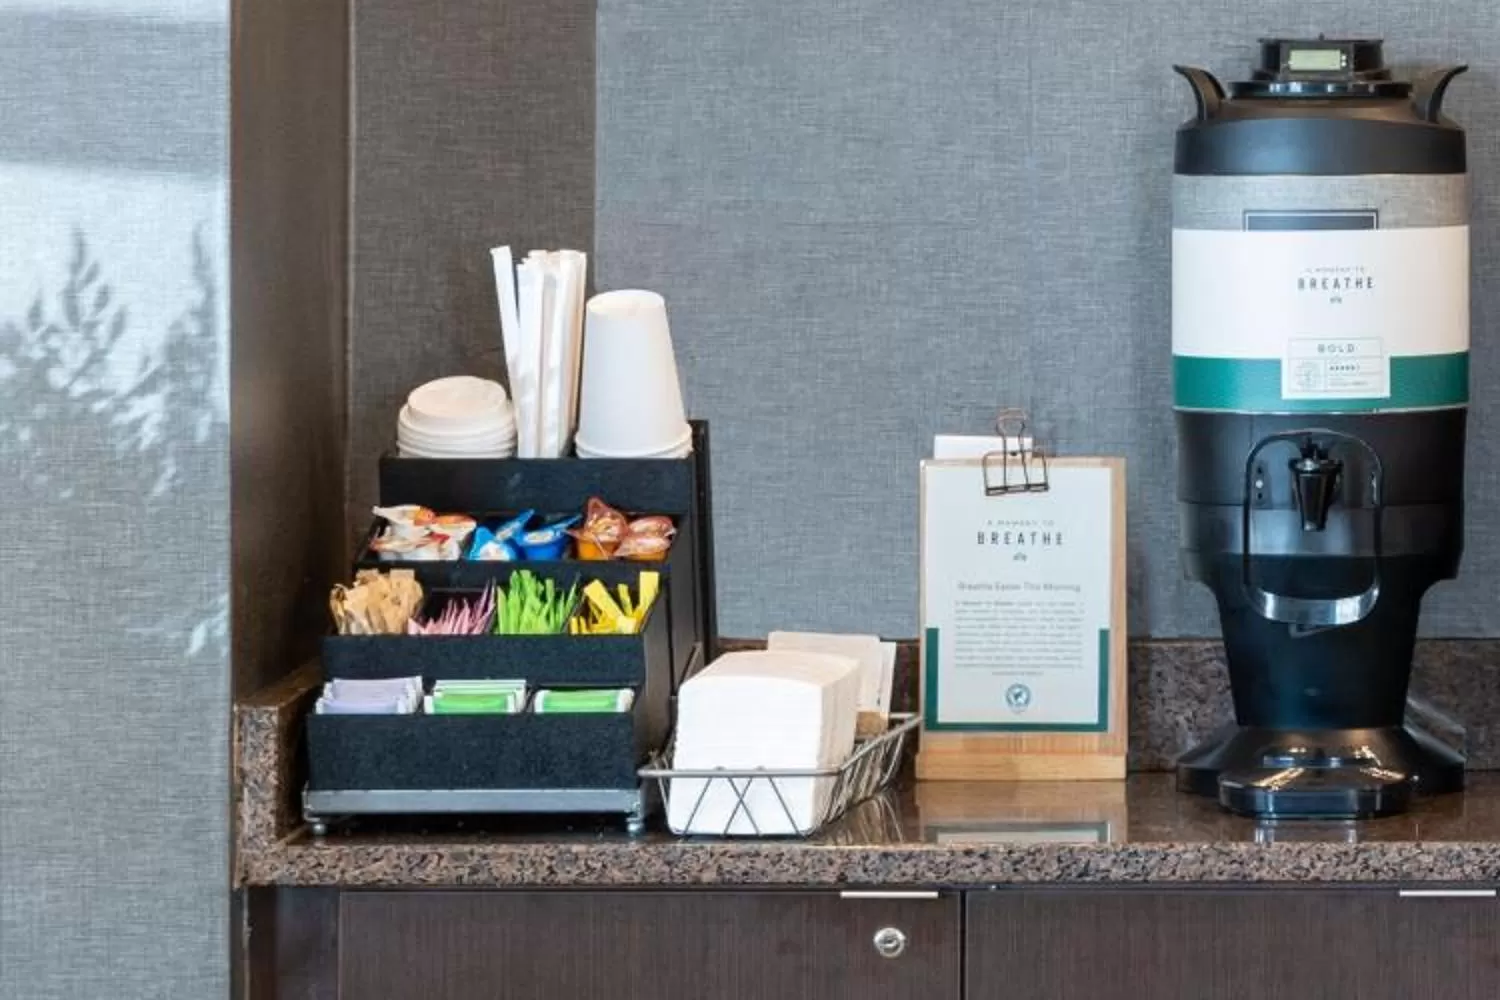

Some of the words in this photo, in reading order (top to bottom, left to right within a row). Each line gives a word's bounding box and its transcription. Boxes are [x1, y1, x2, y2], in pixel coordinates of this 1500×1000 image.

[1297, 276, 1375, 290] BREATHE
[1317, 343, 1355, 353] BOLD
[977, 531, 1063, 545] BREATHE
